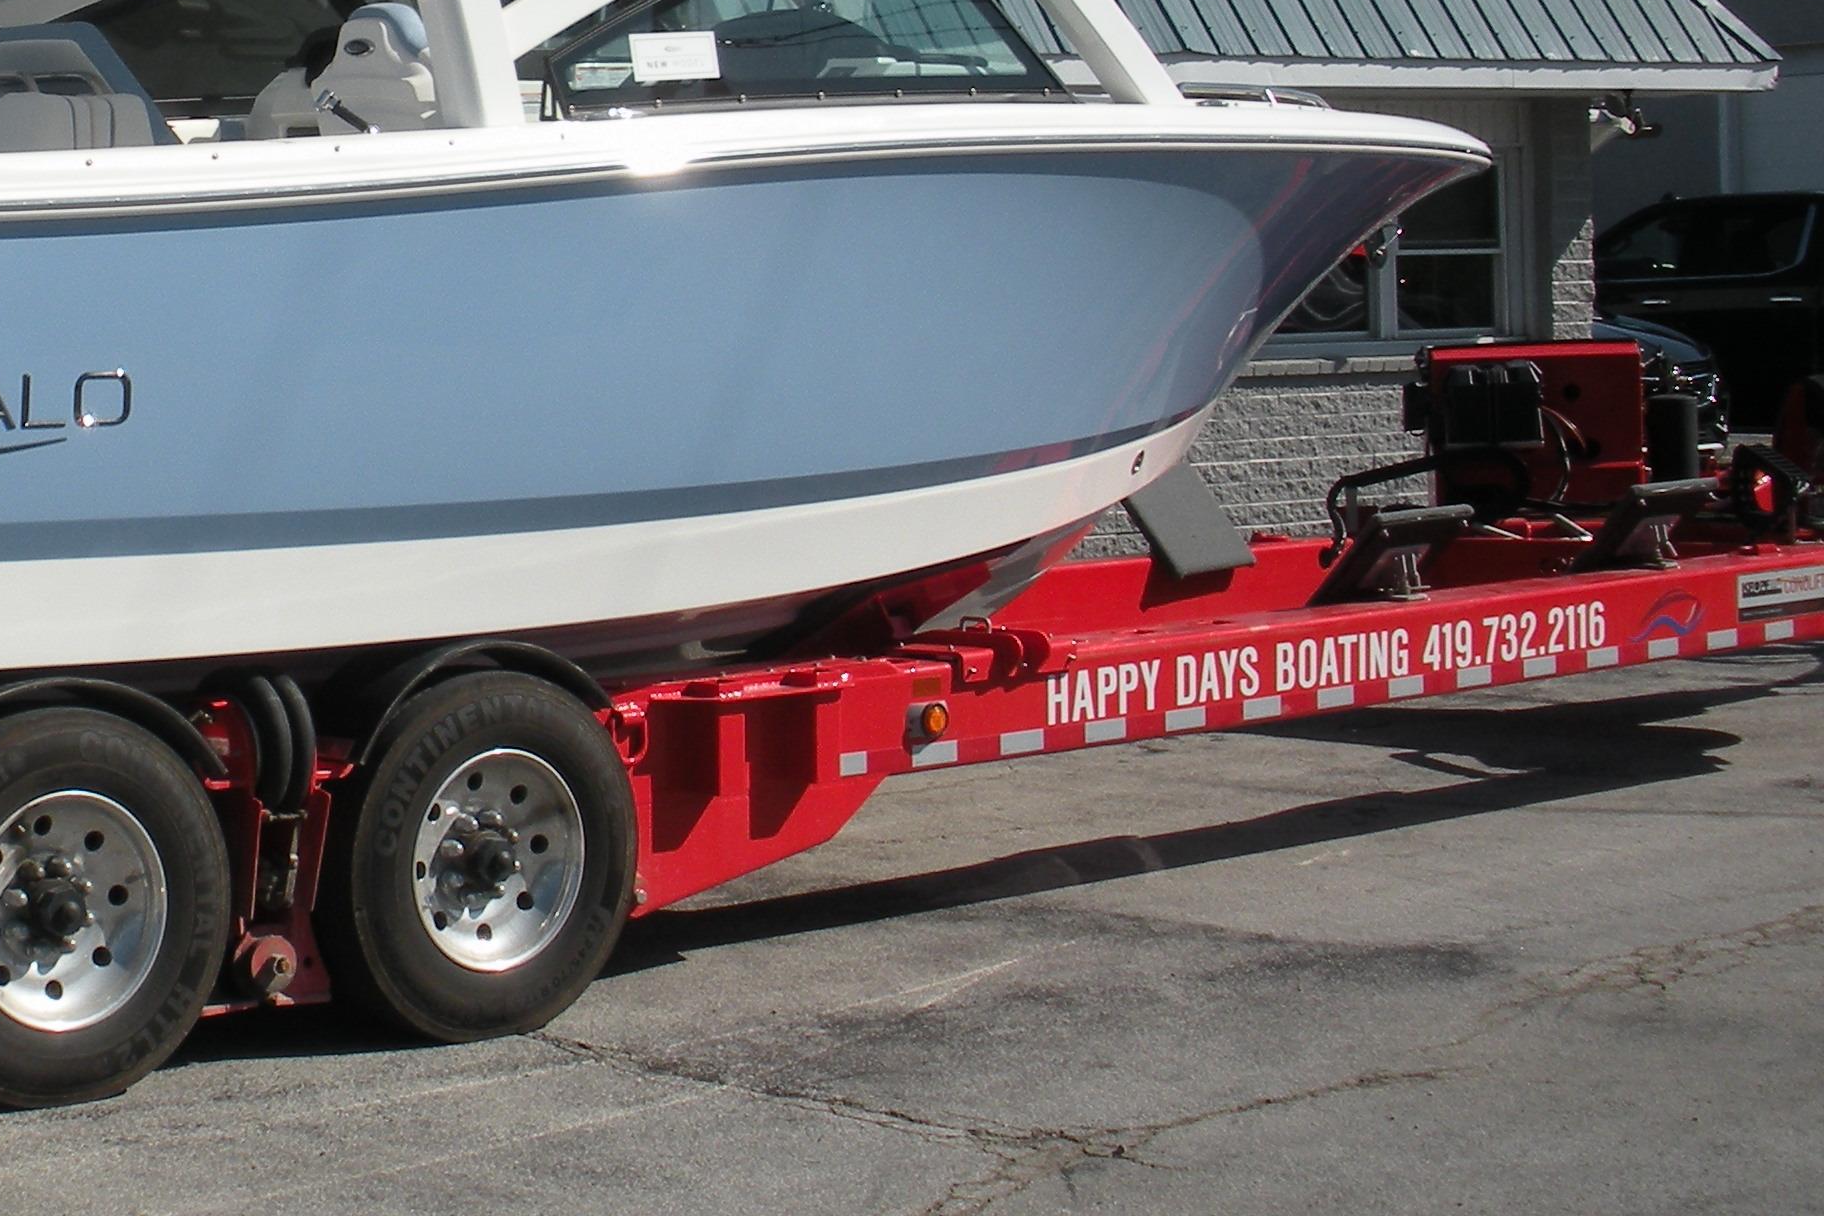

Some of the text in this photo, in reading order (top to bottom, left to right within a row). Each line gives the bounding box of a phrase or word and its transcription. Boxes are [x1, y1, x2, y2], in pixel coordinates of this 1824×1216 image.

[1046, 600, 1607, 726] HAPPY DAYS BOATING 419.732.2116
